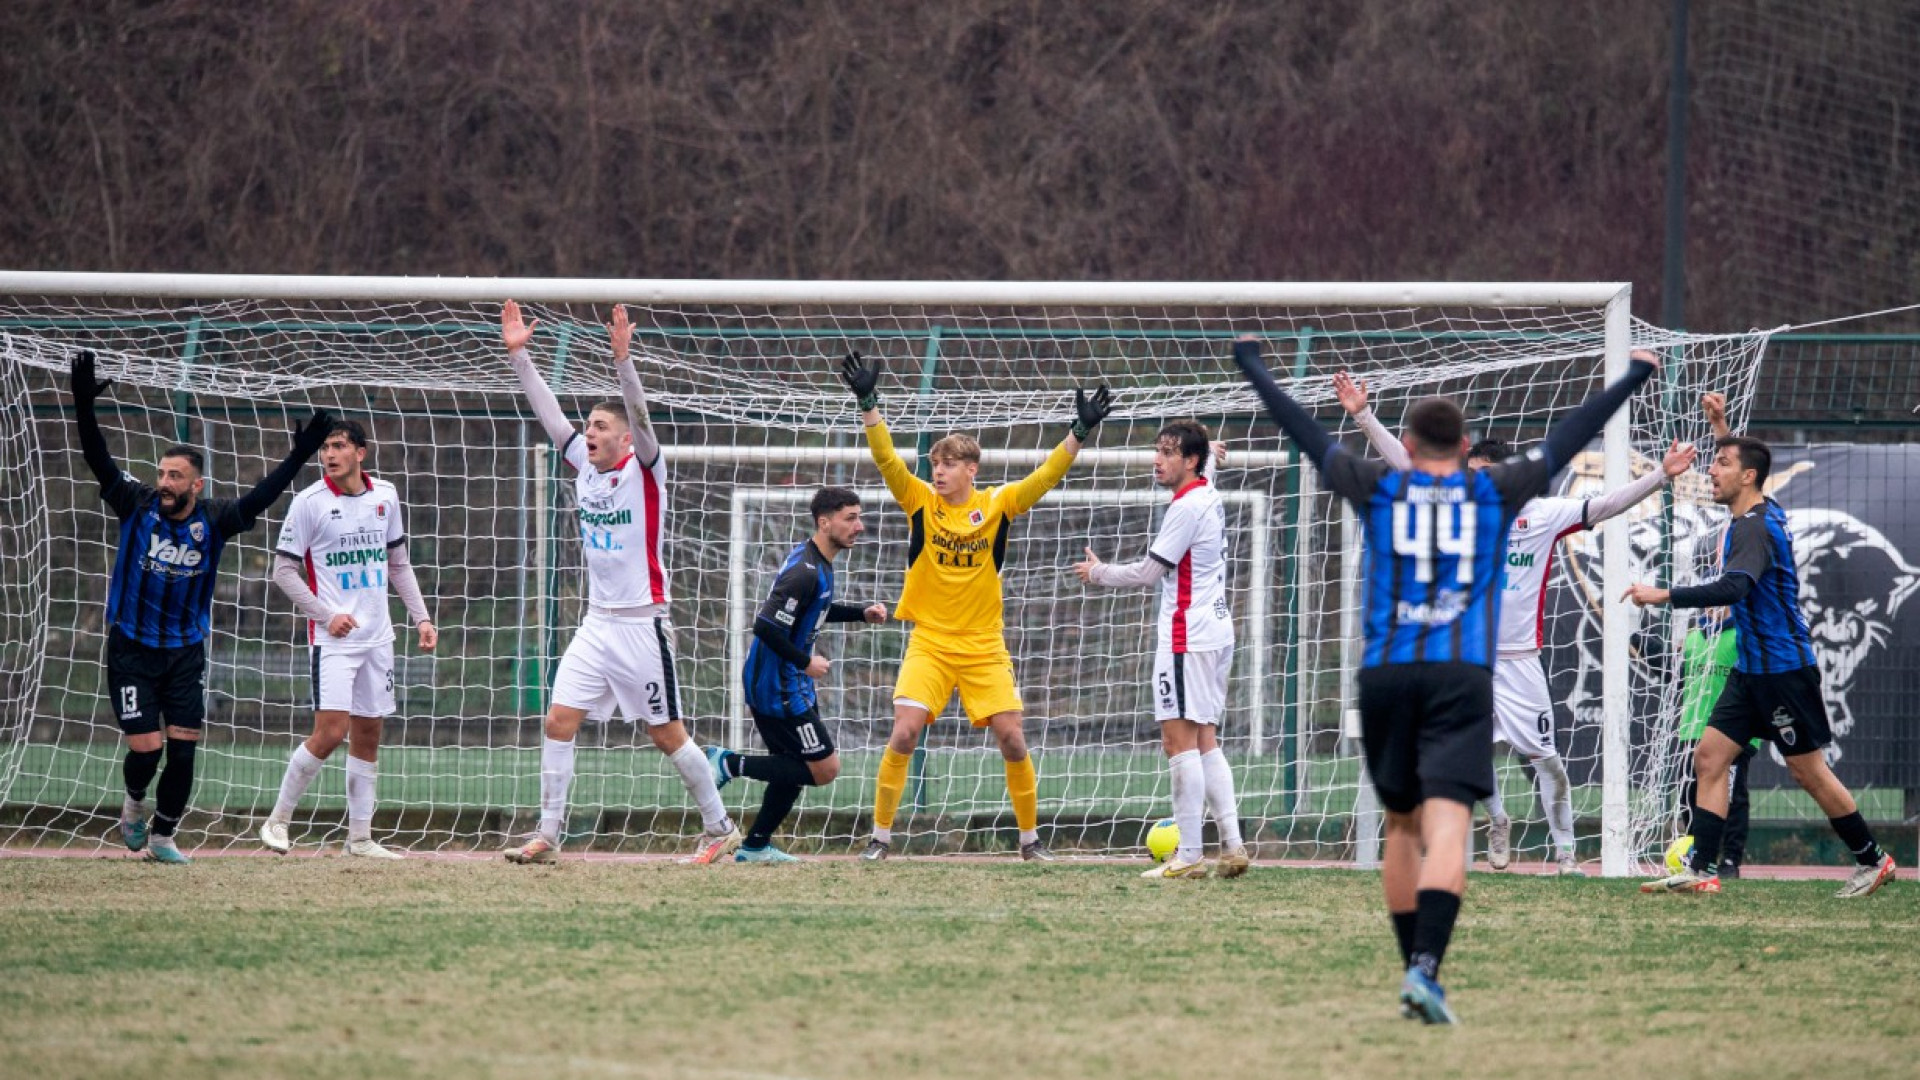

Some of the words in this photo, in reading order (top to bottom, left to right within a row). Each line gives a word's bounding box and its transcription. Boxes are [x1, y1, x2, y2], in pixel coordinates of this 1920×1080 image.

[147, 532, 202, 567] Yale
[1392, 501, 1477, 584] 44
[386, 668, 394, 692] 3
[644, 681, 662, 704] 2
[1158, 671, 1171, 696] 5
[119, 685, 138, 713] 13
[795, 722, 820, 749] 10
[1537, 711, 1550, 735] 6
